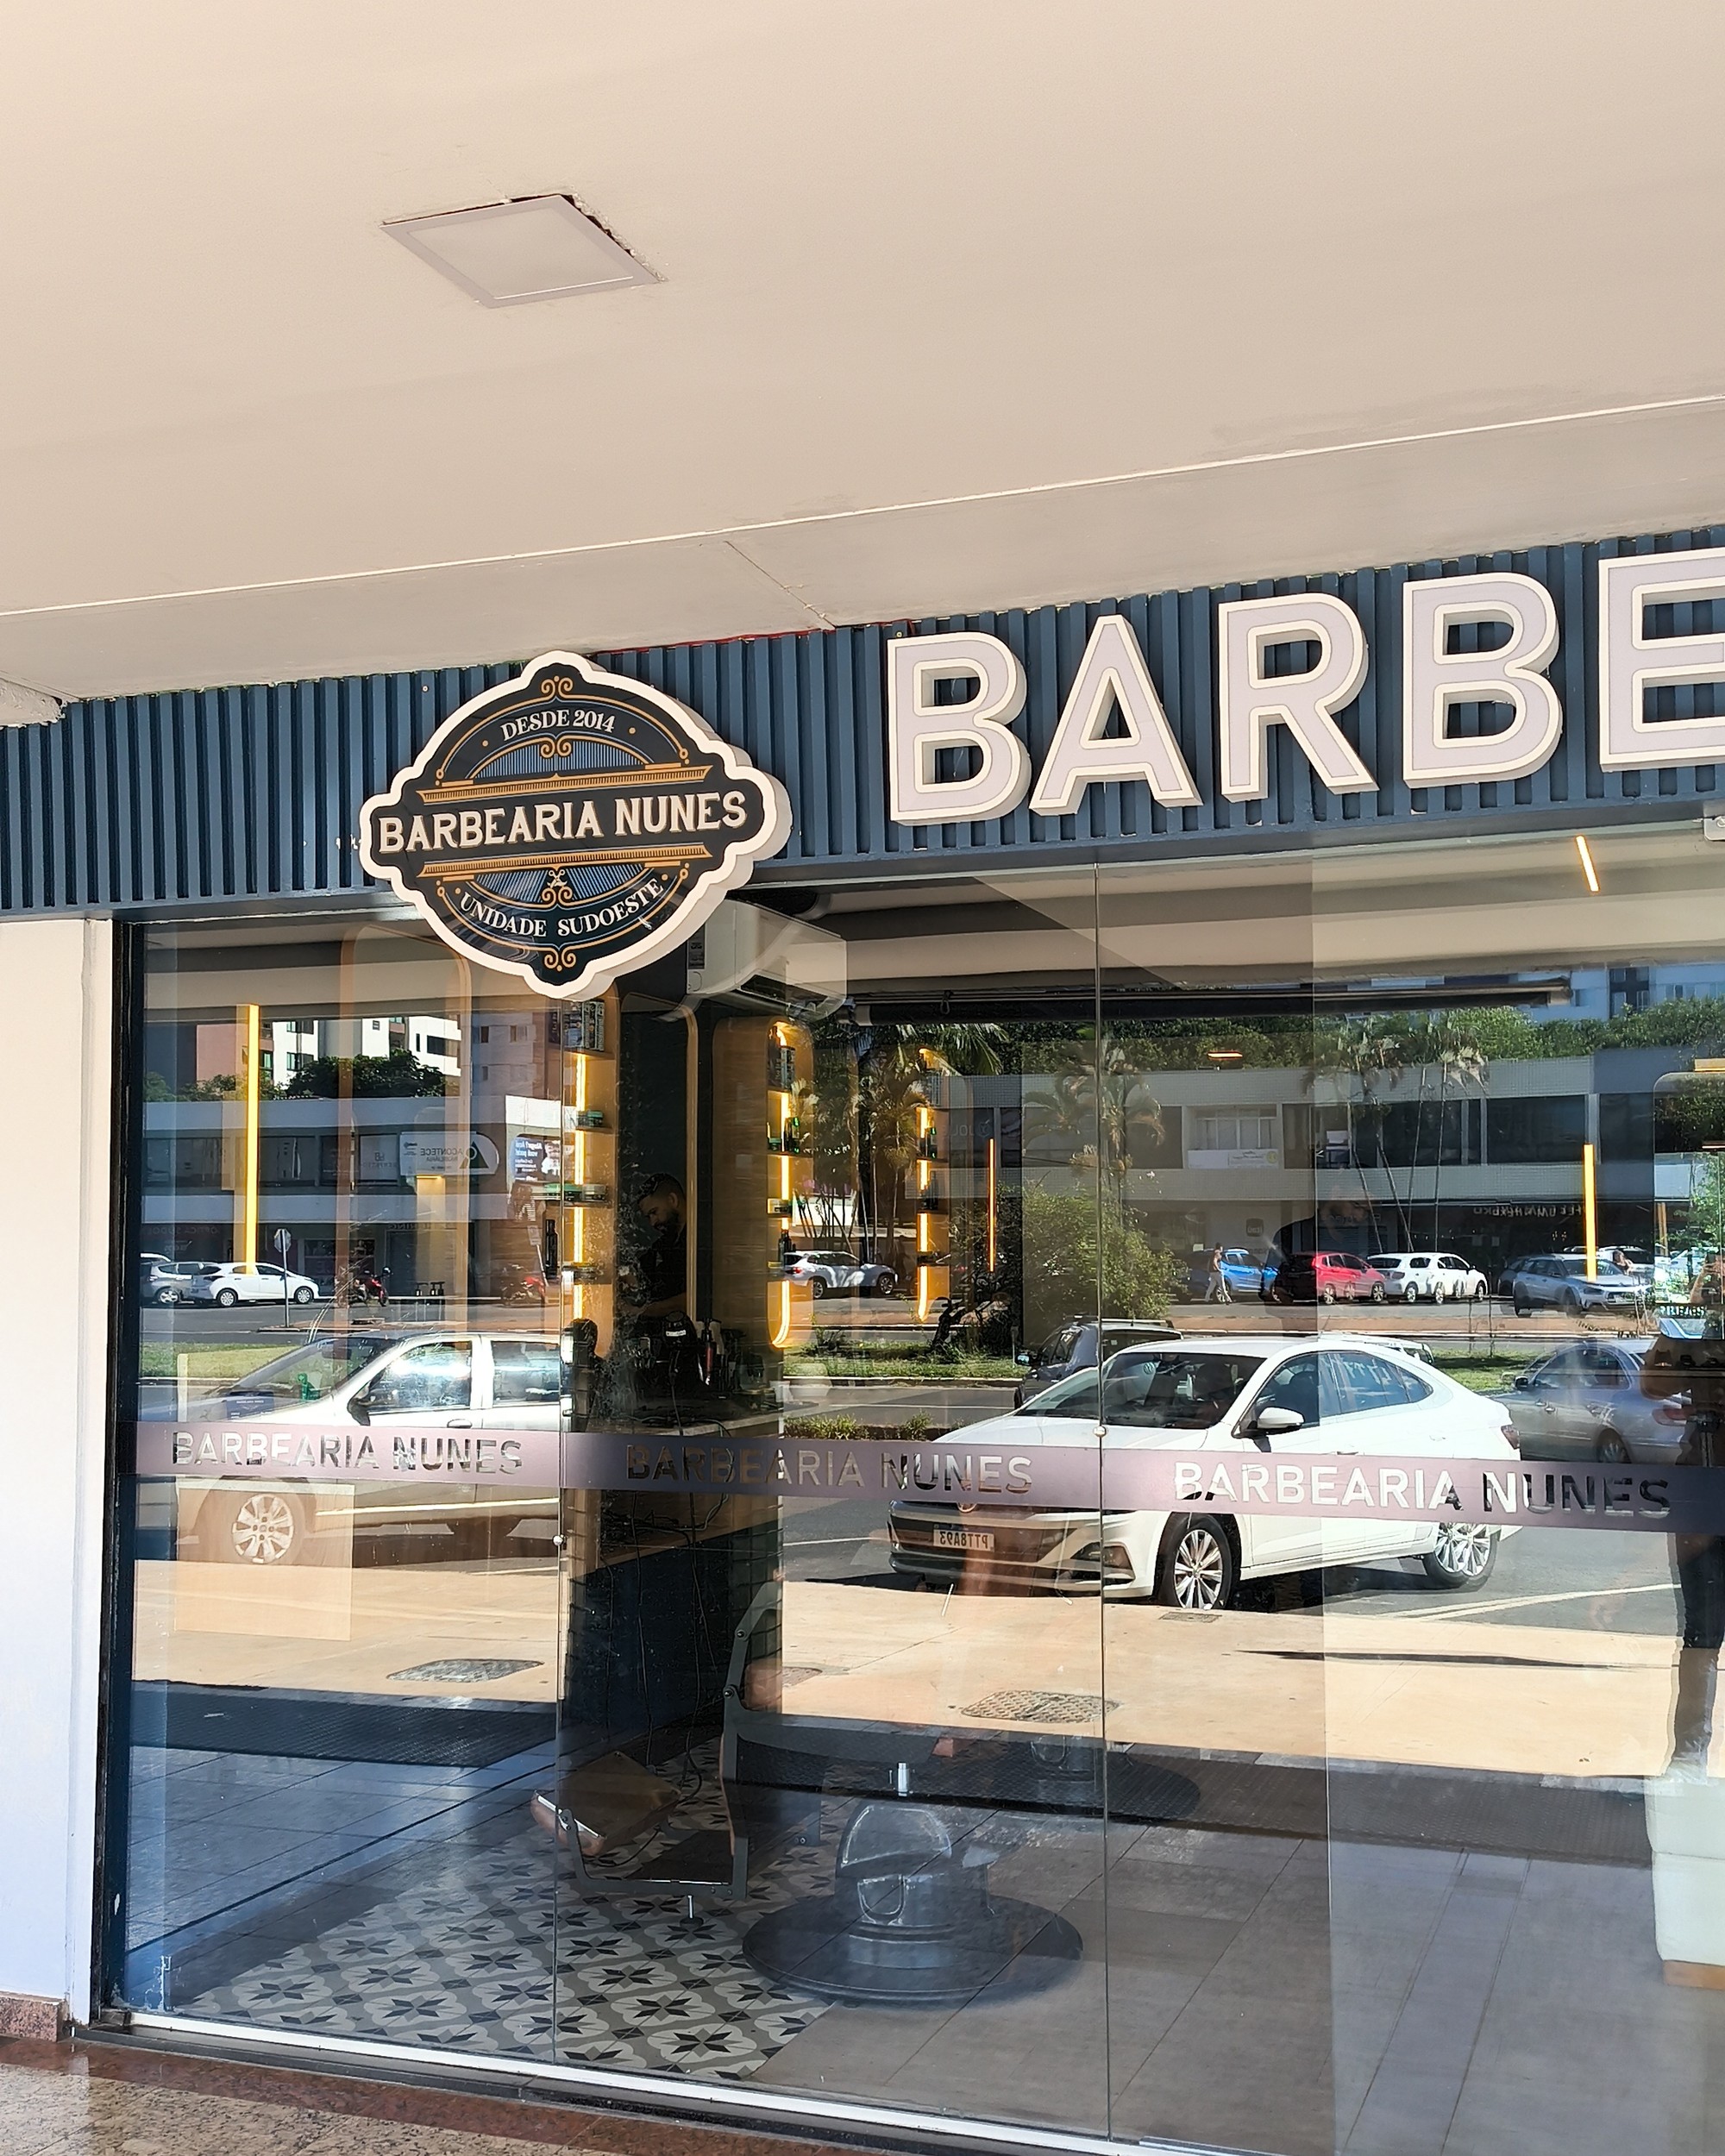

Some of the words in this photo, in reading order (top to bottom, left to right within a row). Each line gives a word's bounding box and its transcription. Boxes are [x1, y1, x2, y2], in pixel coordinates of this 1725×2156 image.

[888, 548, 1725, 827] BARBE
[500, 710, 570, 742] DESDE
[573, 709, 615, 733] 2014
[377, 800, 604, 855] BARBEARIA
[614, 791, 749, 837] NUNES
[460, 892, 548, 938] UNIDADE
[557, 878, 664, 937] SUDOESTE
[172, 1431, 379, 1470] BARBEARIA
[393, 1436, 523, 1475] NUNES
[626, 1444, 865, 1489] BARBEARIA
[882, 1452, 1032, 1494] NUNES
[1175, 1462, 1464, 1511] BARBEARIA
[1482, 1470, 1671, 1518] NUNES
